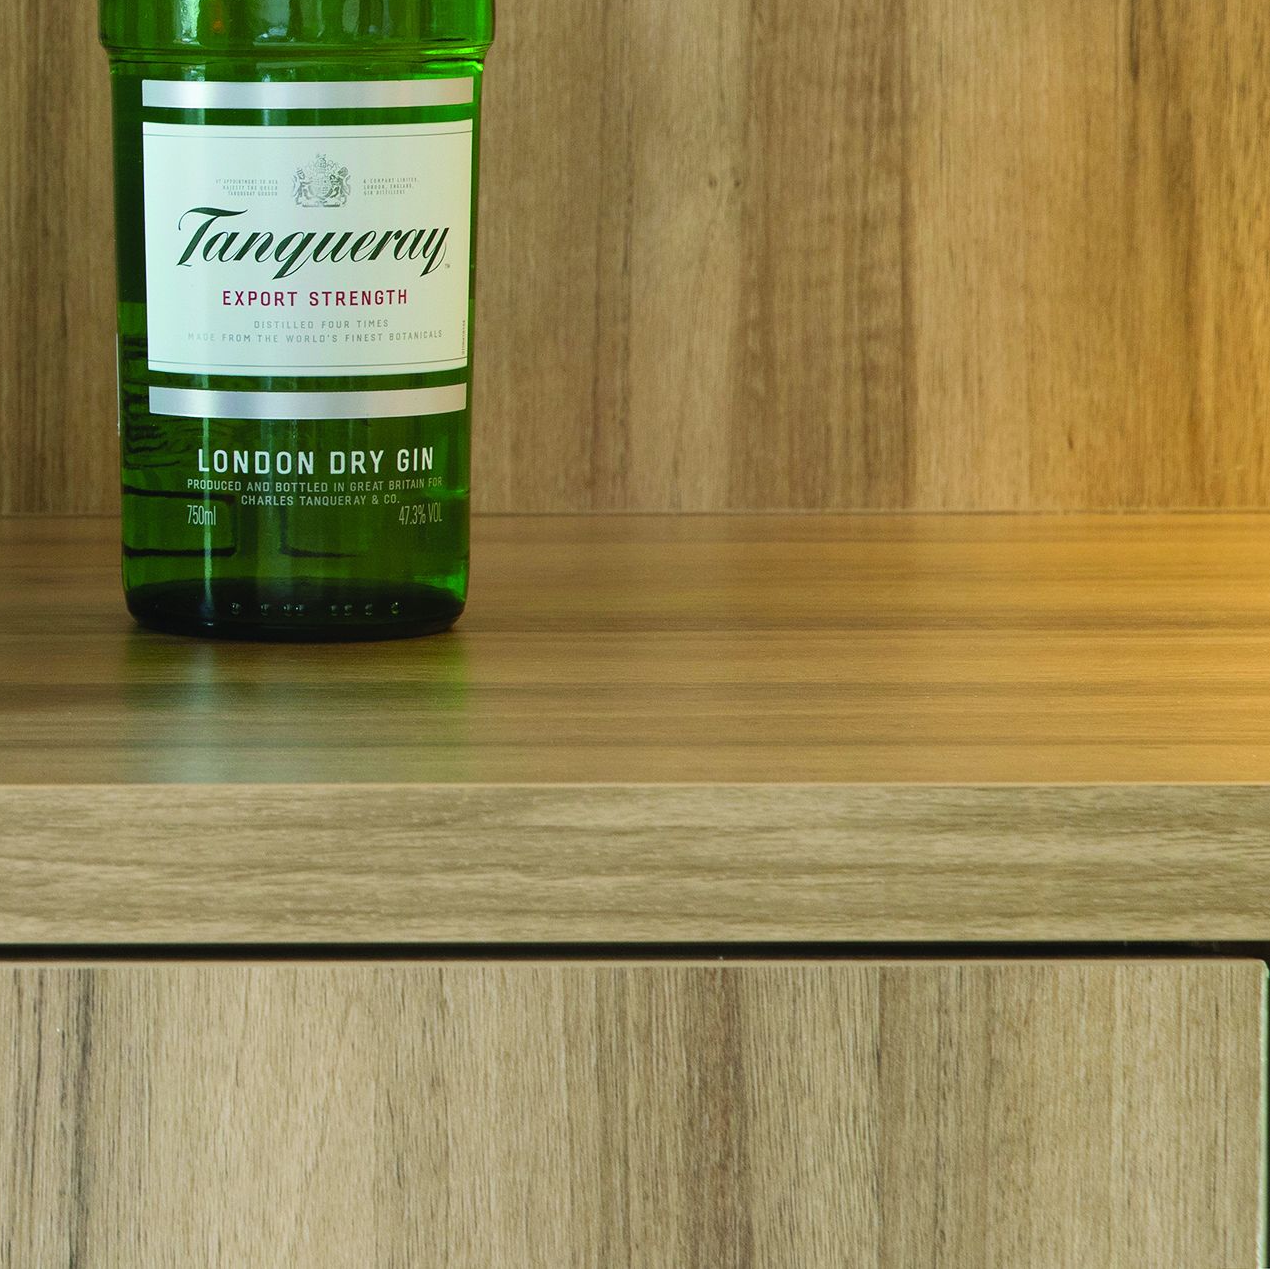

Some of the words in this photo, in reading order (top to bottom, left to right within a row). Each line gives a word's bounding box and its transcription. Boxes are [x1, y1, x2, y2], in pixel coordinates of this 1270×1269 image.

[176, 207, 449, 280] Tanqueray
[222, 290, 298, 307] EXPORT
[309, 288, 409, 307] STRENGTH
[253, 320, 314, 330] DISTILLED
[321, 320, 350, 329] FOUR
[357, 319, 389, 329] TIMES
[221, 334, 251, 343] FROM
[257, 334, 278, 343] THE
[345, 332, 383, 343] FINEST
[389, 330, 443, 342] BOTANICALS
[197, 448, 314, 475] LONDON
[329, 449, 385, 475] DRY
[396, 446, 434, 473] GIN
[187, 478, 242, 492] PRODUCED
[246, 481, 270, 492] AND
[275, 482, 328, 493] BOTTLED
[333, 482, 344, 492] IN
[350, 481, 384, 492] GREAT
[388, 478, 425, 490] BRITAIN
[428, 476, 443, 488] FOR
[241, 494, 294, 506] CHARLES
[299, 495, 367, 506] TANQUERAY
[371, 494, 379, 505] &
[383, 494, 400, 505] CO.
[427, 502, 443, 523] VOL
